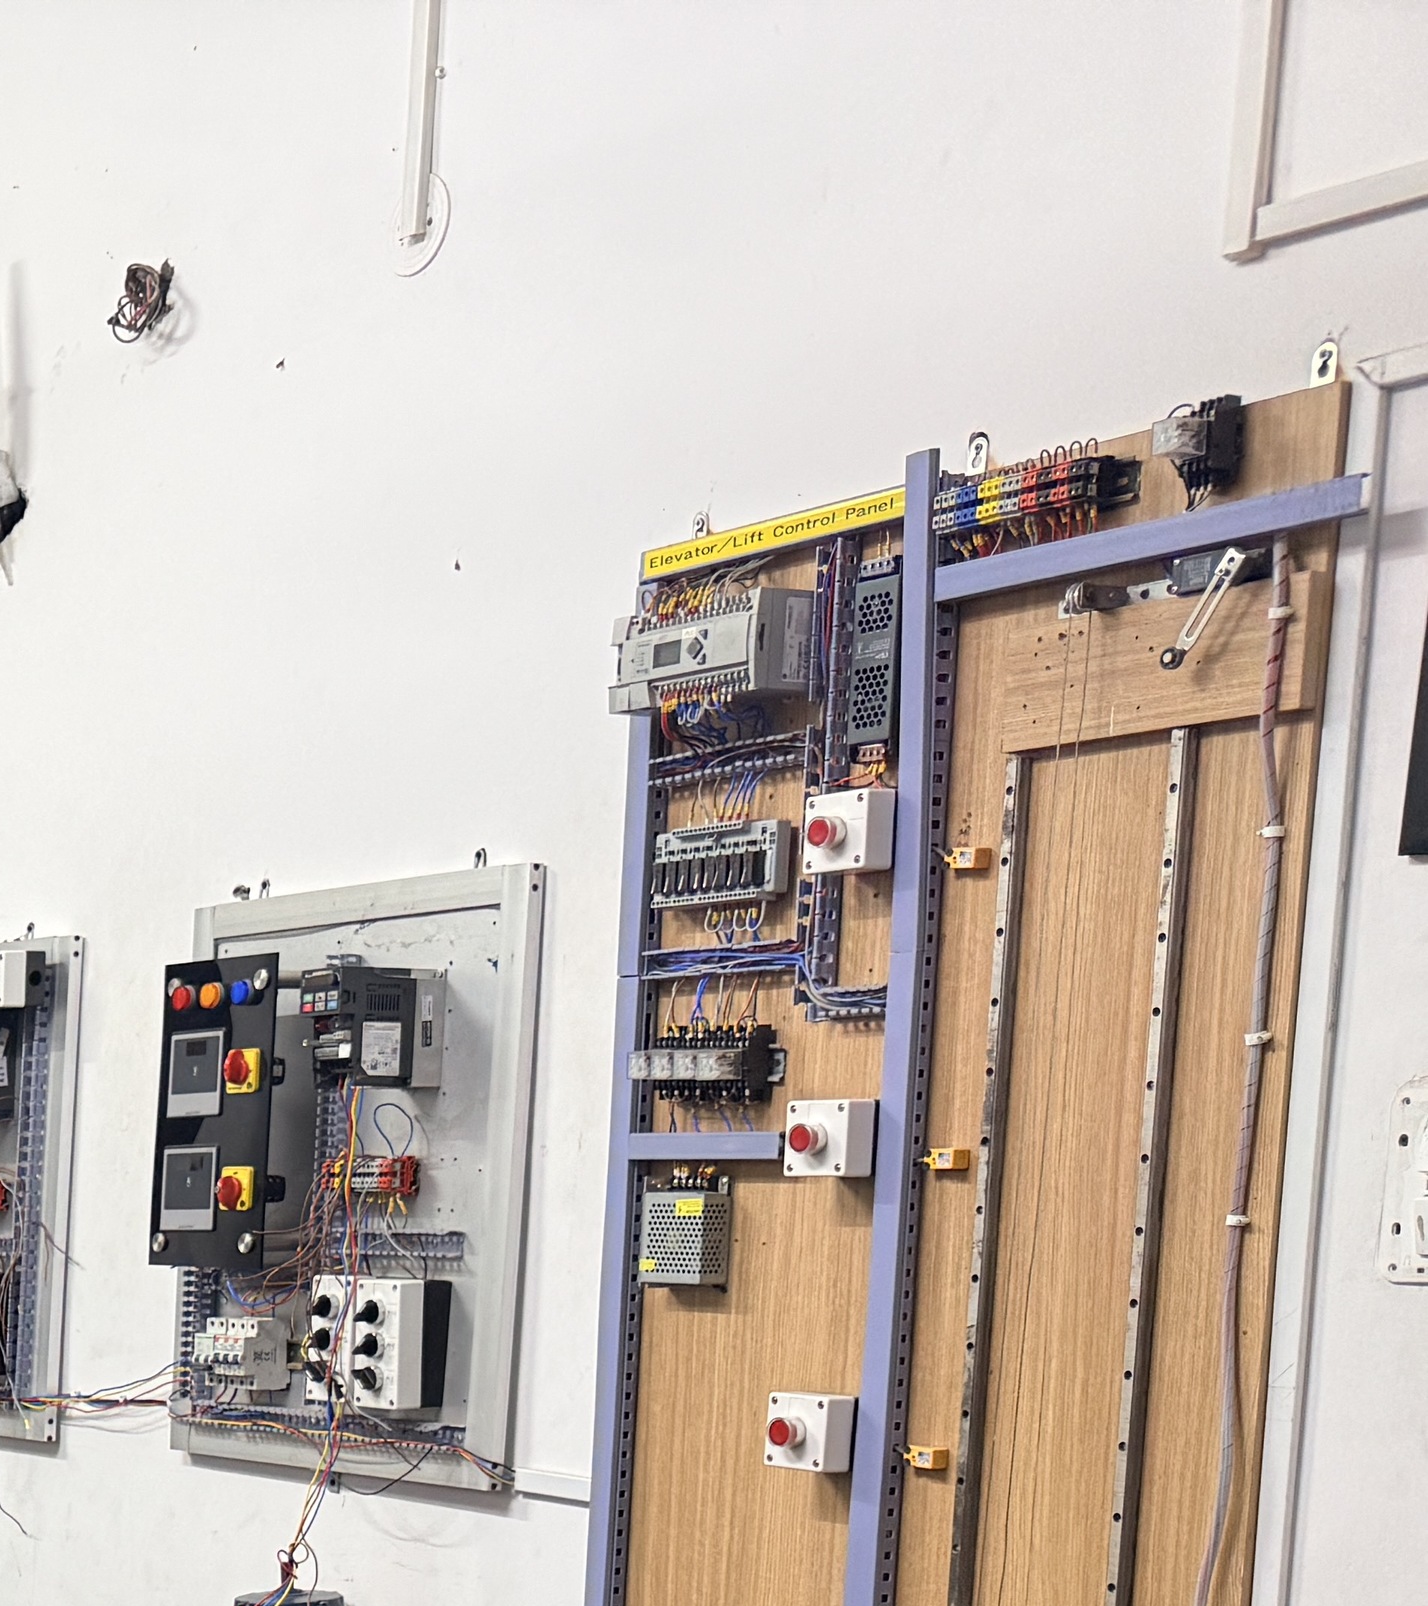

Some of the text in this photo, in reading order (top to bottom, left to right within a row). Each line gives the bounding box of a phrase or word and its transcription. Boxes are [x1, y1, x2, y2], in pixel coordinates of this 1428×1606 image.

[649, 497, 894, 569] Elevator/Lift Control Panel
